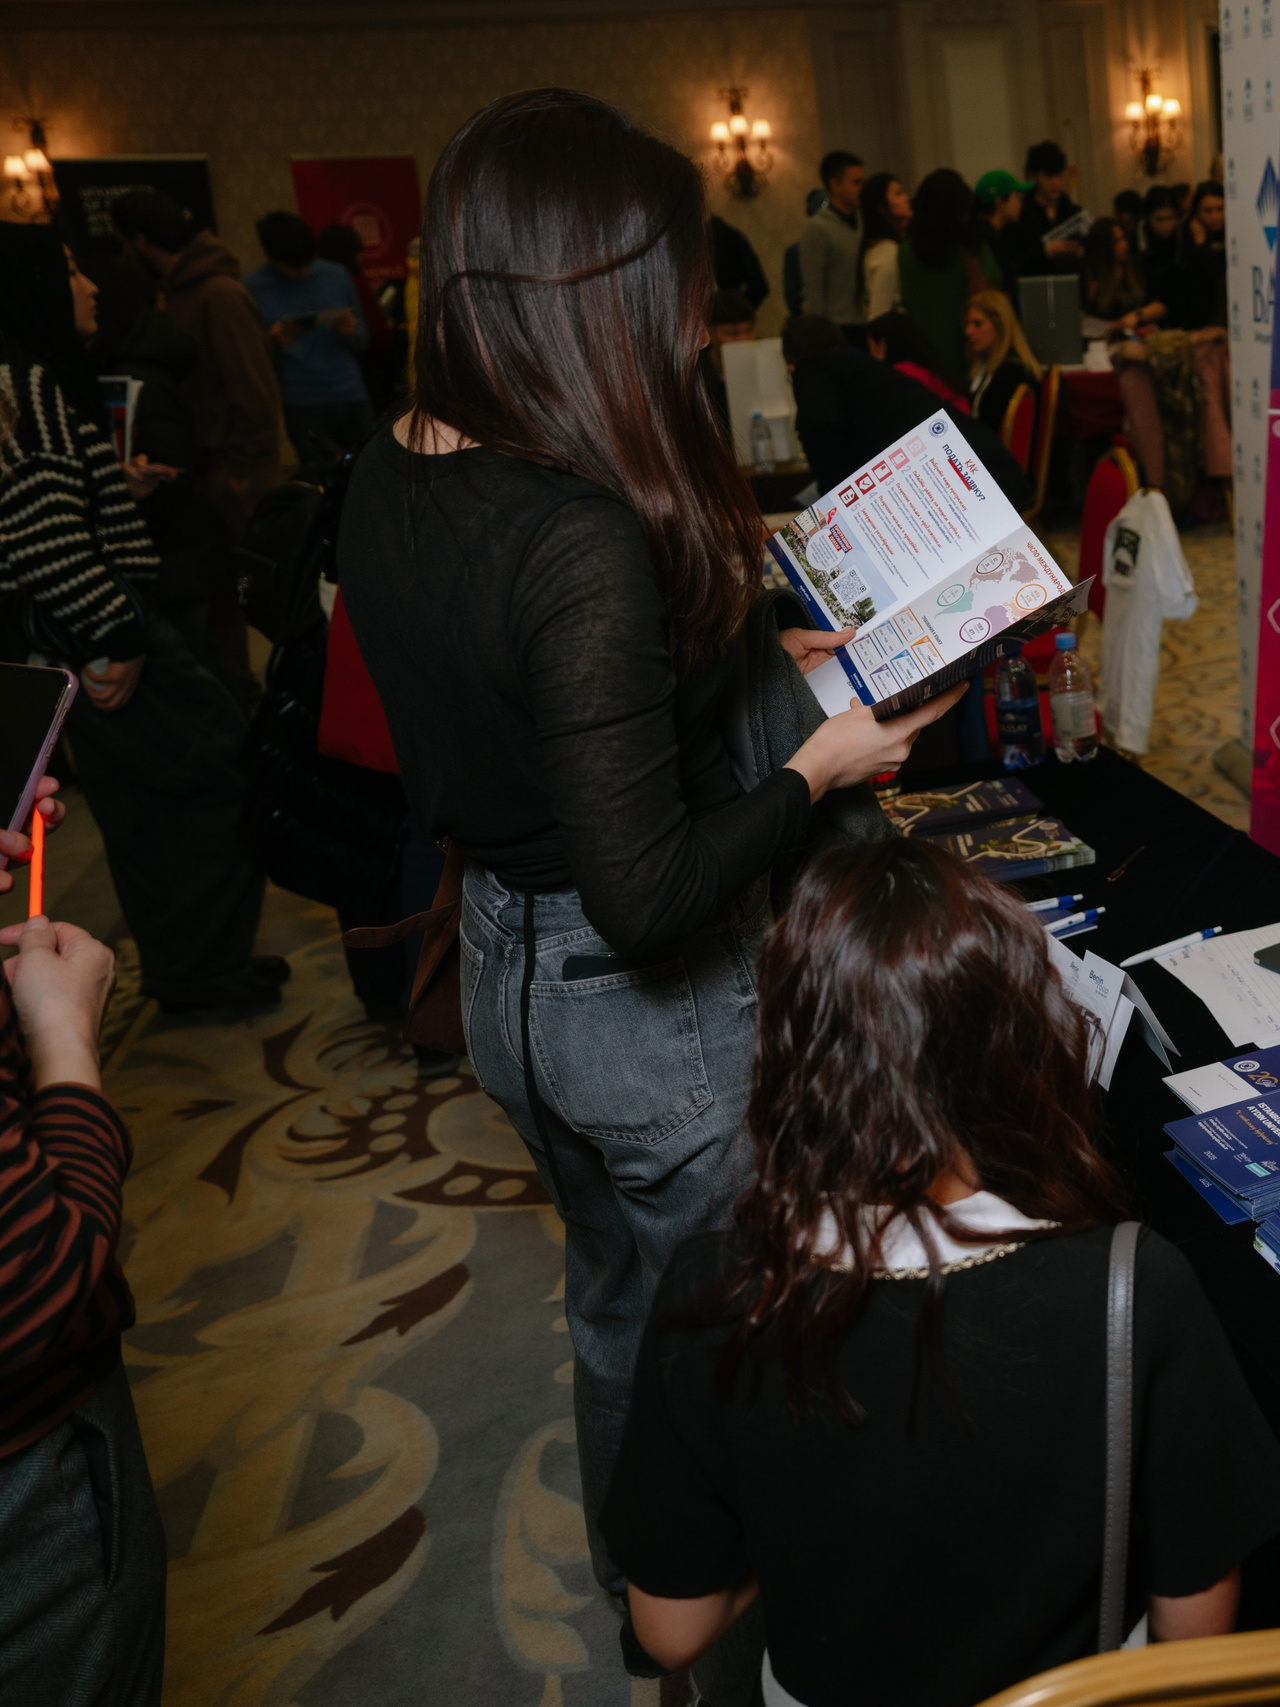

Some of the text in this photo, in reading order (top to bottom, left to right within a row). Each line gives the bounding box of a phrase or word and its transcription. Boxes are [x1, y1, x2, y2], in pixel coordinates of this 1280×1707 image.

[941, 443, 964, 472] ПОДАТЬ
[960, 470, 985, 502] ЗАЯВКУ?
[965, 458, 979, 475] КАК
[1025, 541, 1039, 558] ЧИСЛО
[1246, 1105, 1268, 1123] AYDIN
[1203, 1150, 1218, 1161] 2025
